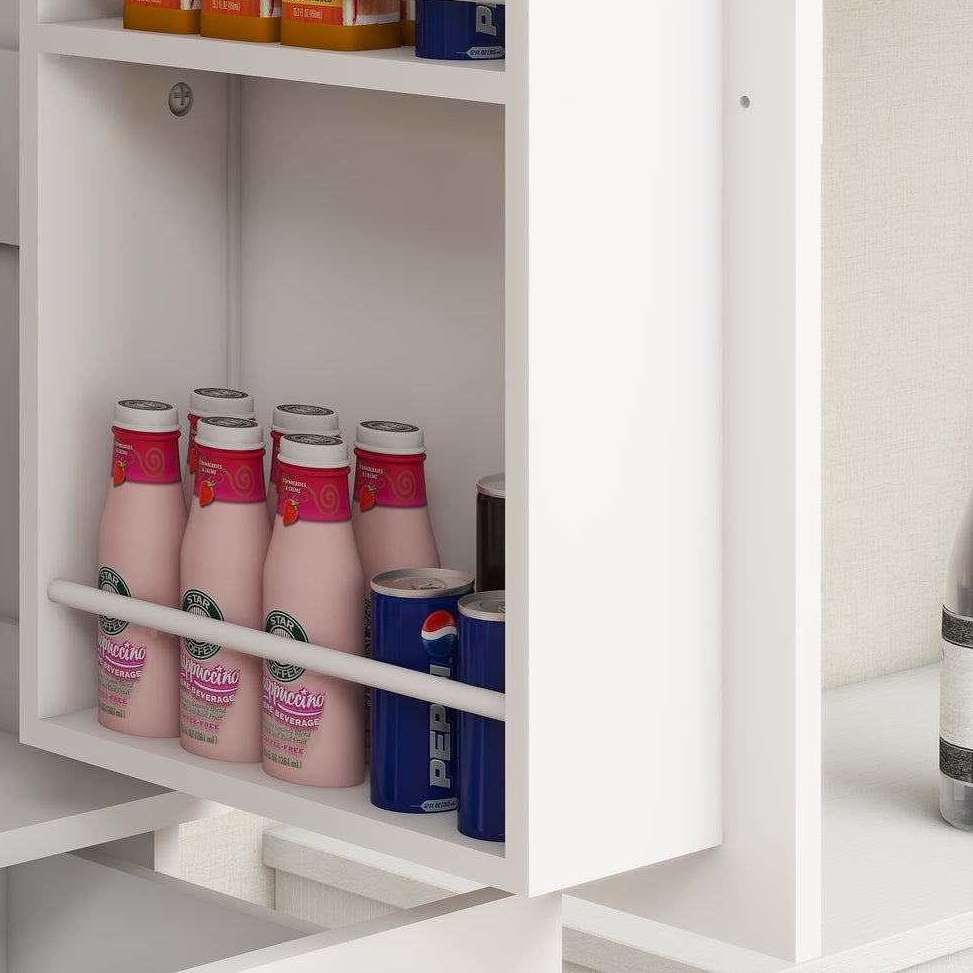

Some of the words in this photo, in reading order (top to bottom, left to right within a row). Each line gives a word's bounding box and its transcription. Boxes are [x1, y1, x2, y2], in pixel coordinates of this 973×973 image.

[101, 571, 119, 587] STAR
[187, 594, 210, 610] STAR
[270, 615, 295, 631] STAR
[99, 636, 146, 661] ppuccino
[186, 639, 217, 655] OFFEE
[181, 655, 240, 686] appuccino
[191, 687, 235, 703] BEVERAGE
[263, 677, 325, 708] appuccino
[181, 714, 220, 730] OFFEE-FREE
[274, 710, 320, 727] BEVERAGE
[429, 664, 450, 789] PEPI
